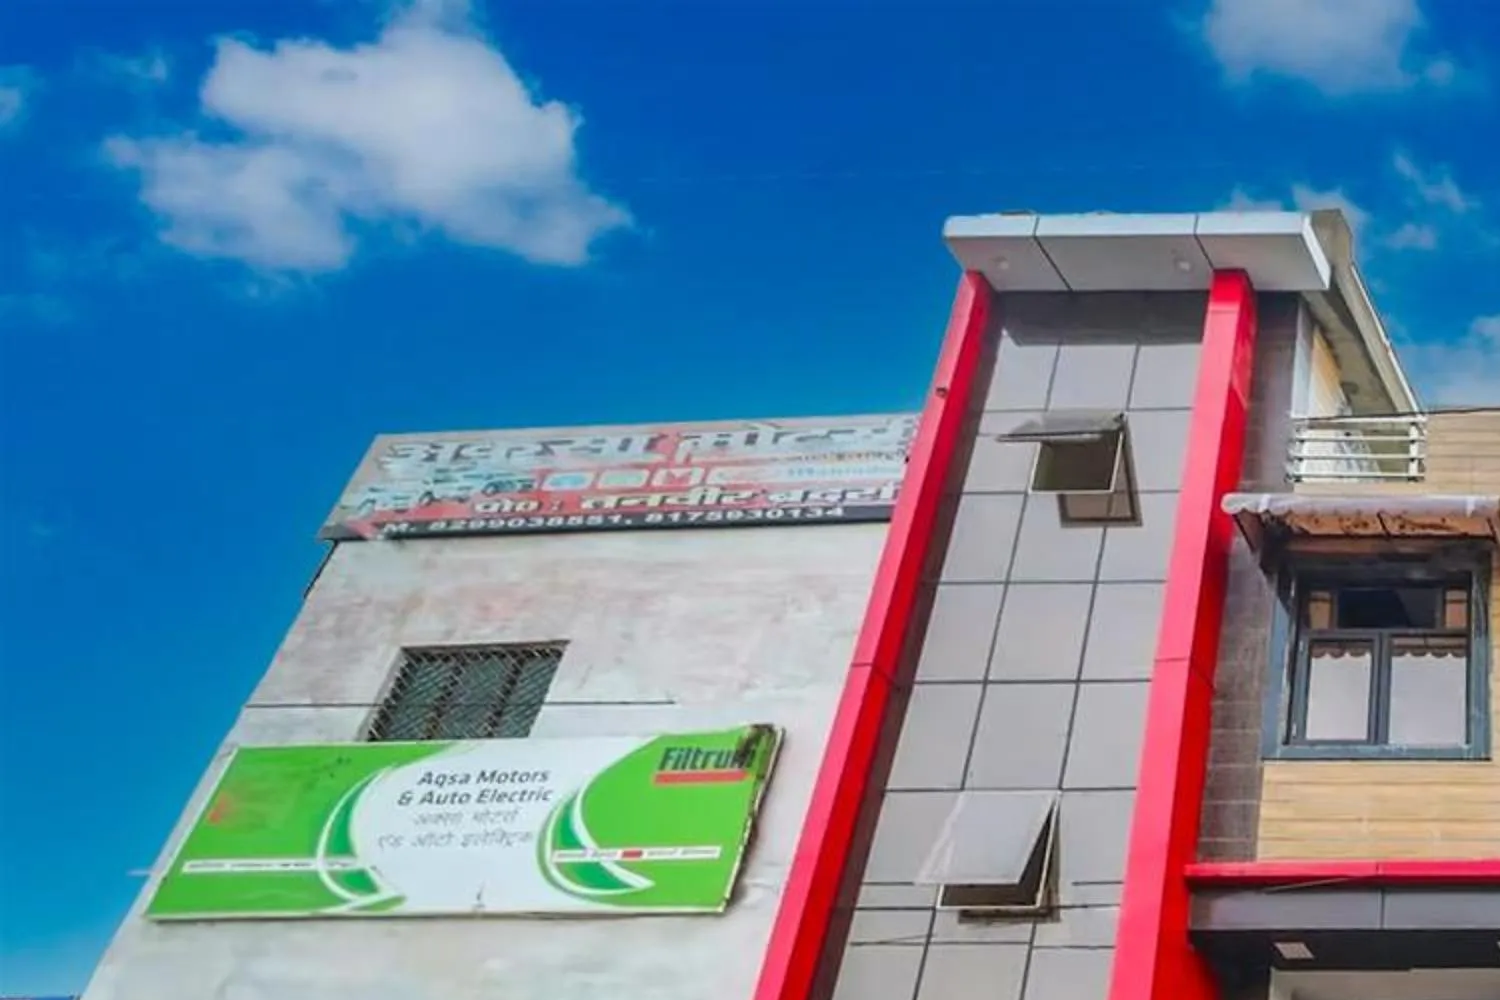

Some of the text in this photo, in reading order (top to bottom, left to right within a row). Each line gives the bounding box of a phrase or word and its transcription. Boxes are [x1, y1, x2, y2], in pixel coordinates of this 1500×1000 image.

[417, 770, 551, 788] Aqsa Motors
[397, 787, 554, 806] & Auto Electric
